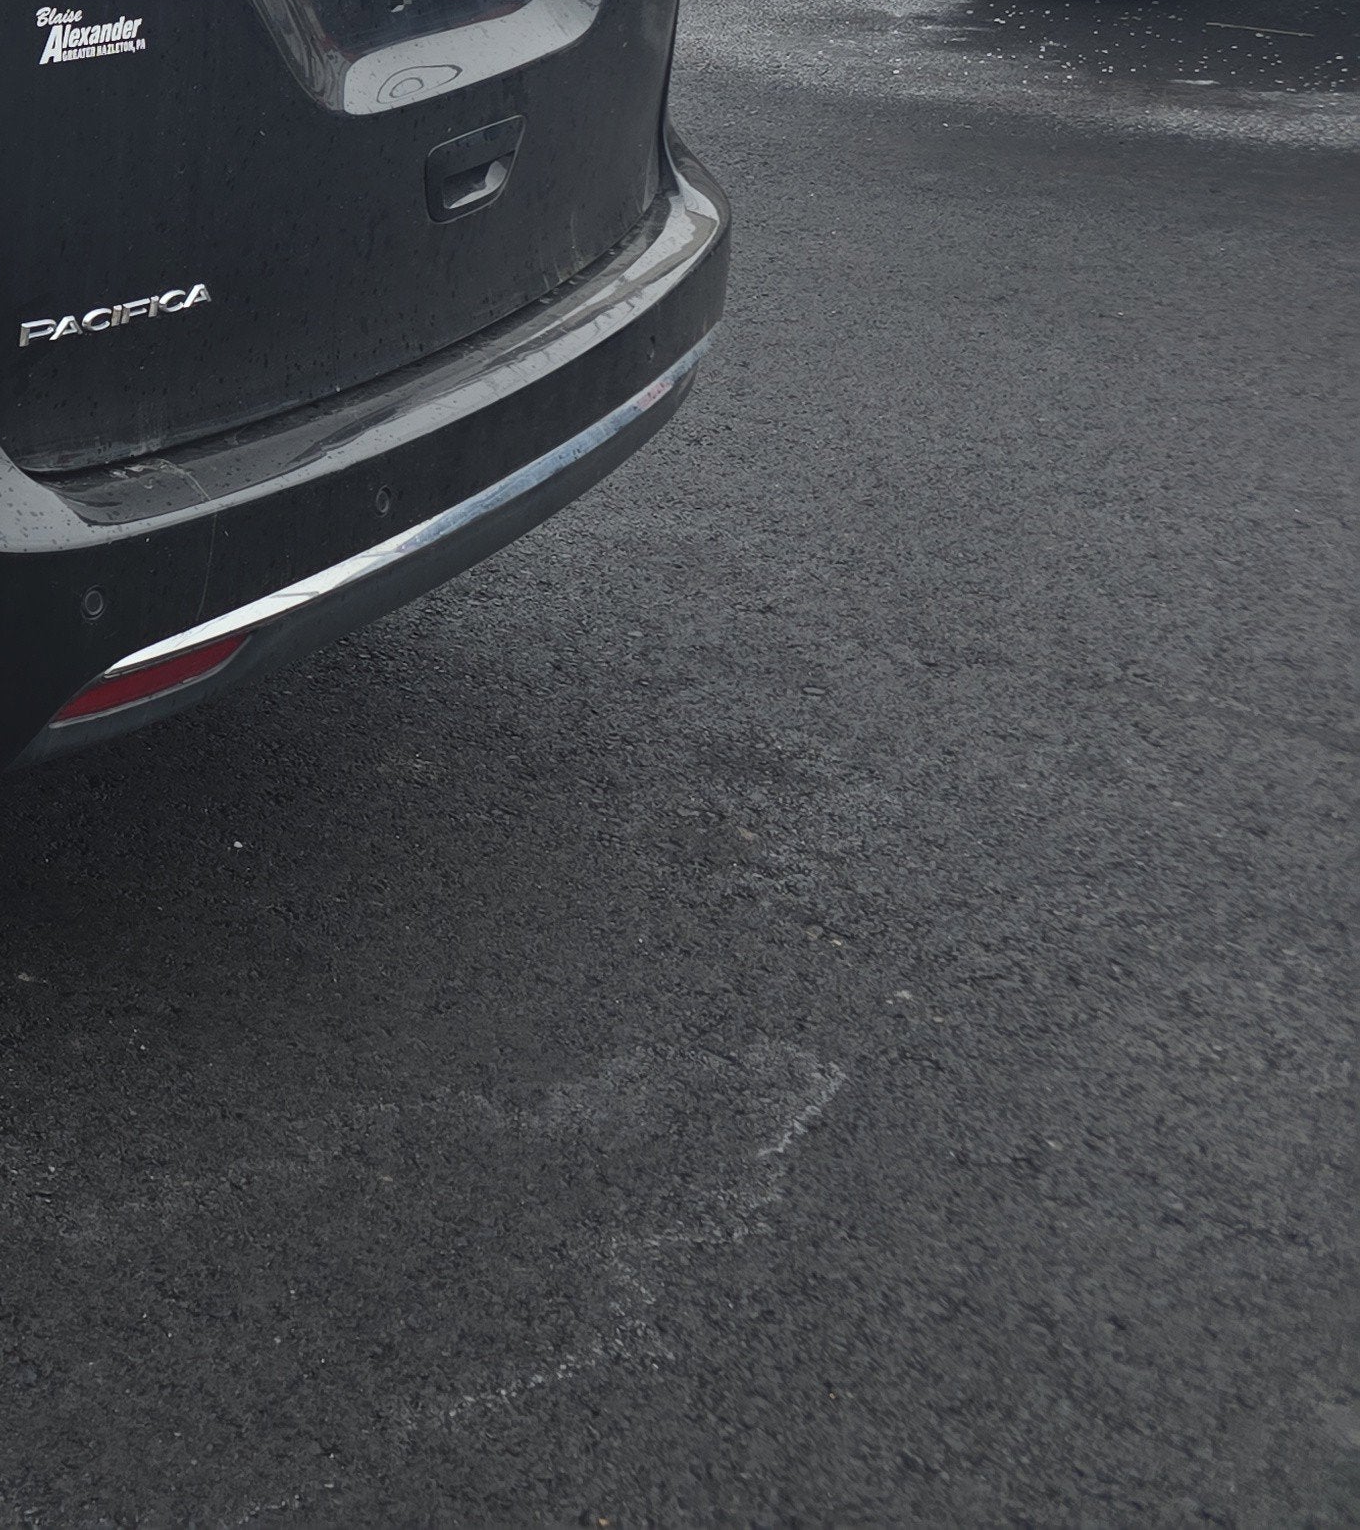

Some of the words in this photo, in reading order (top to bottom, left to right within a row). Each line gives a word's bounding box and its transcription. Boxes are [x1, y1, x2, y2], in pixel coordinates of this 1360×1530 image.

[36, 7, 82, 27] Blaise
[39, 16, 142, 64] Alexander
[62, 46, 96, 62] GREATER
[19, 283, 212, 347] PACIFICA
